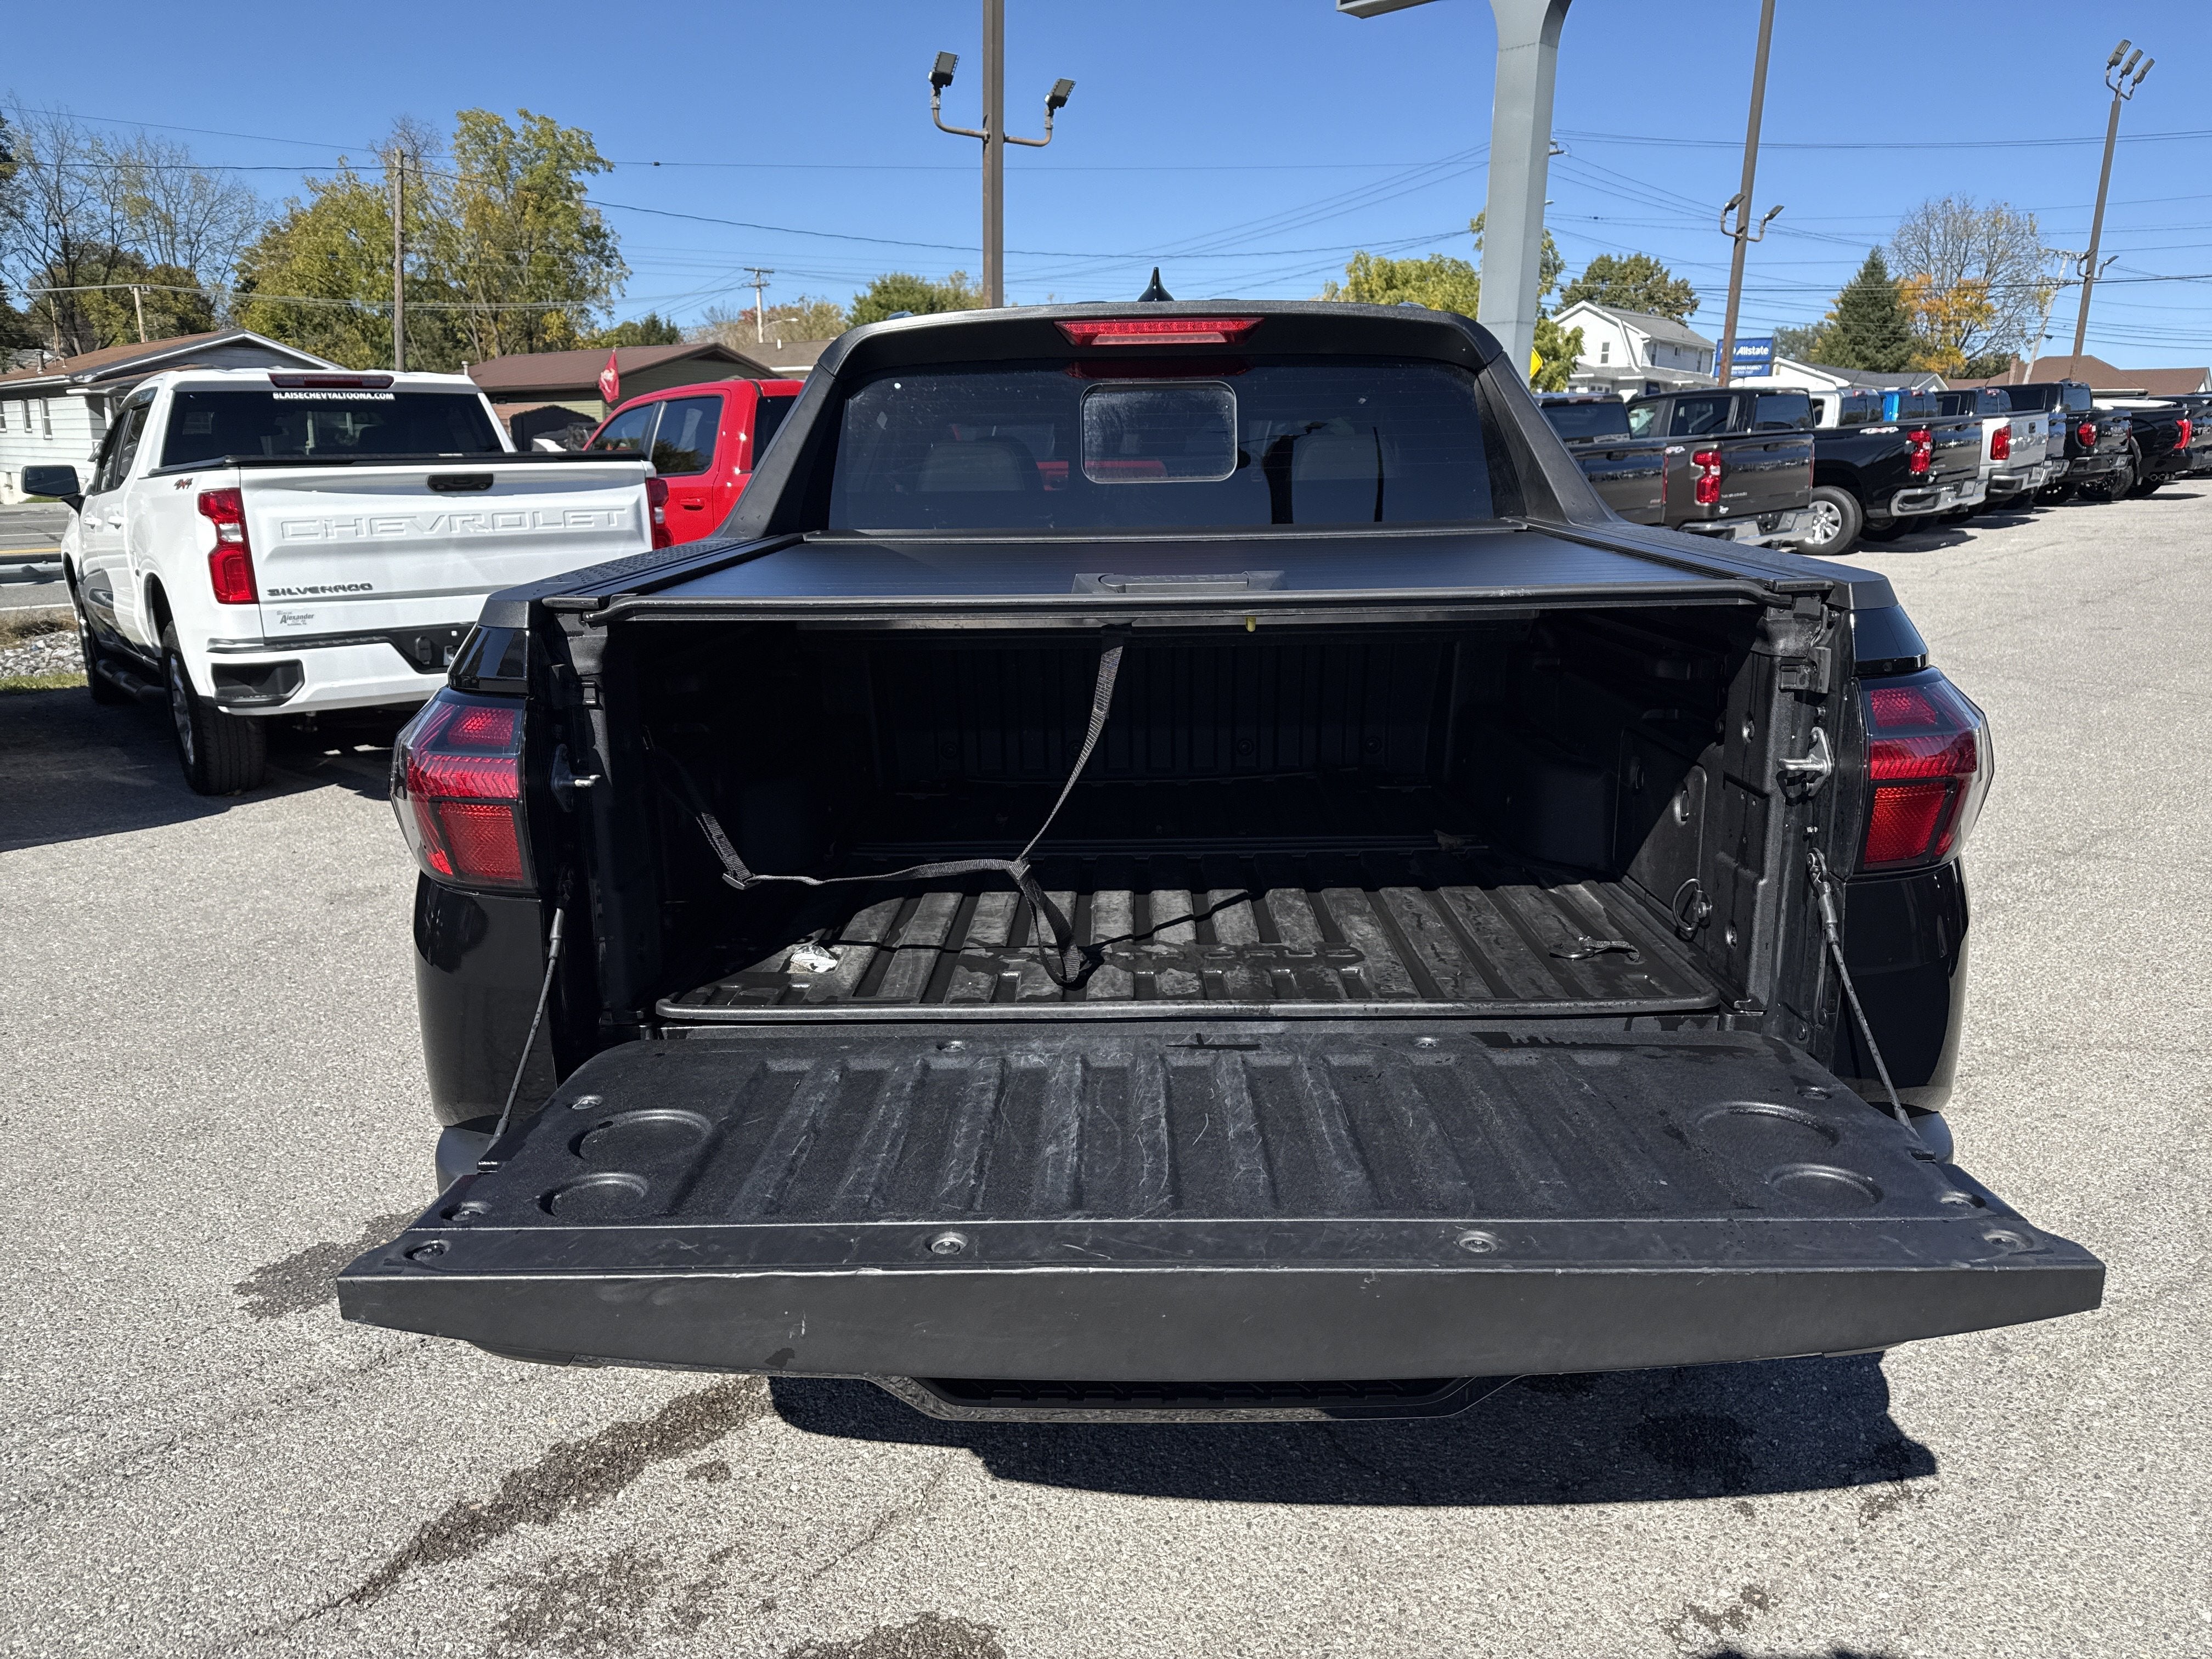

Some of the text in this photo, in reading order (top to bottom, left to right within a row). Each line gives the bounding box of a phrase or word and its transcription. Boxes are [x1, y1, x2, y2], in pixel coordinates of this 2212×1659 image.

[1736, 345, 1769, 355] Allstate
[273, 392, 395, 400] BLAISECHEVYALTOONA.COM
[281, 508, 627, 540] CHEVROLET
[267, 583, 373, 596] SILVERADO
[280, 613, 314, 624] Alexander
